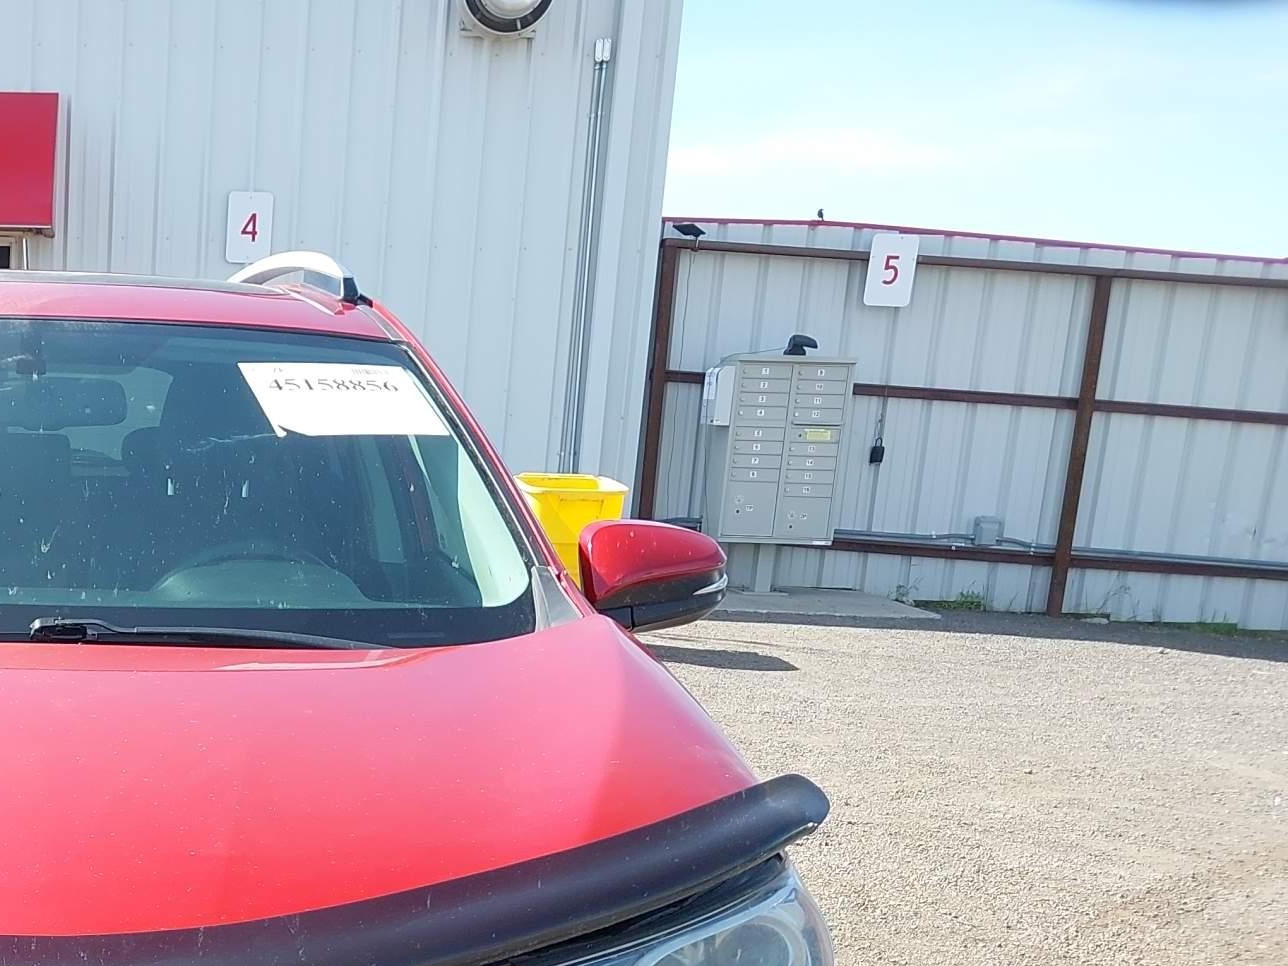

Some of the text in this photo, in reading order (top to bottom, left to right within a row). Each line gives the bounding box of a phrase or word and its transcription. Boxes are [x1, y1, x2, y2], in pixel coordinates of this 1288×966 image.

[240, 212, 258, 243] 4
[881, 255, 900, 286] 5
[269, 378, 399, 392] 45158856
